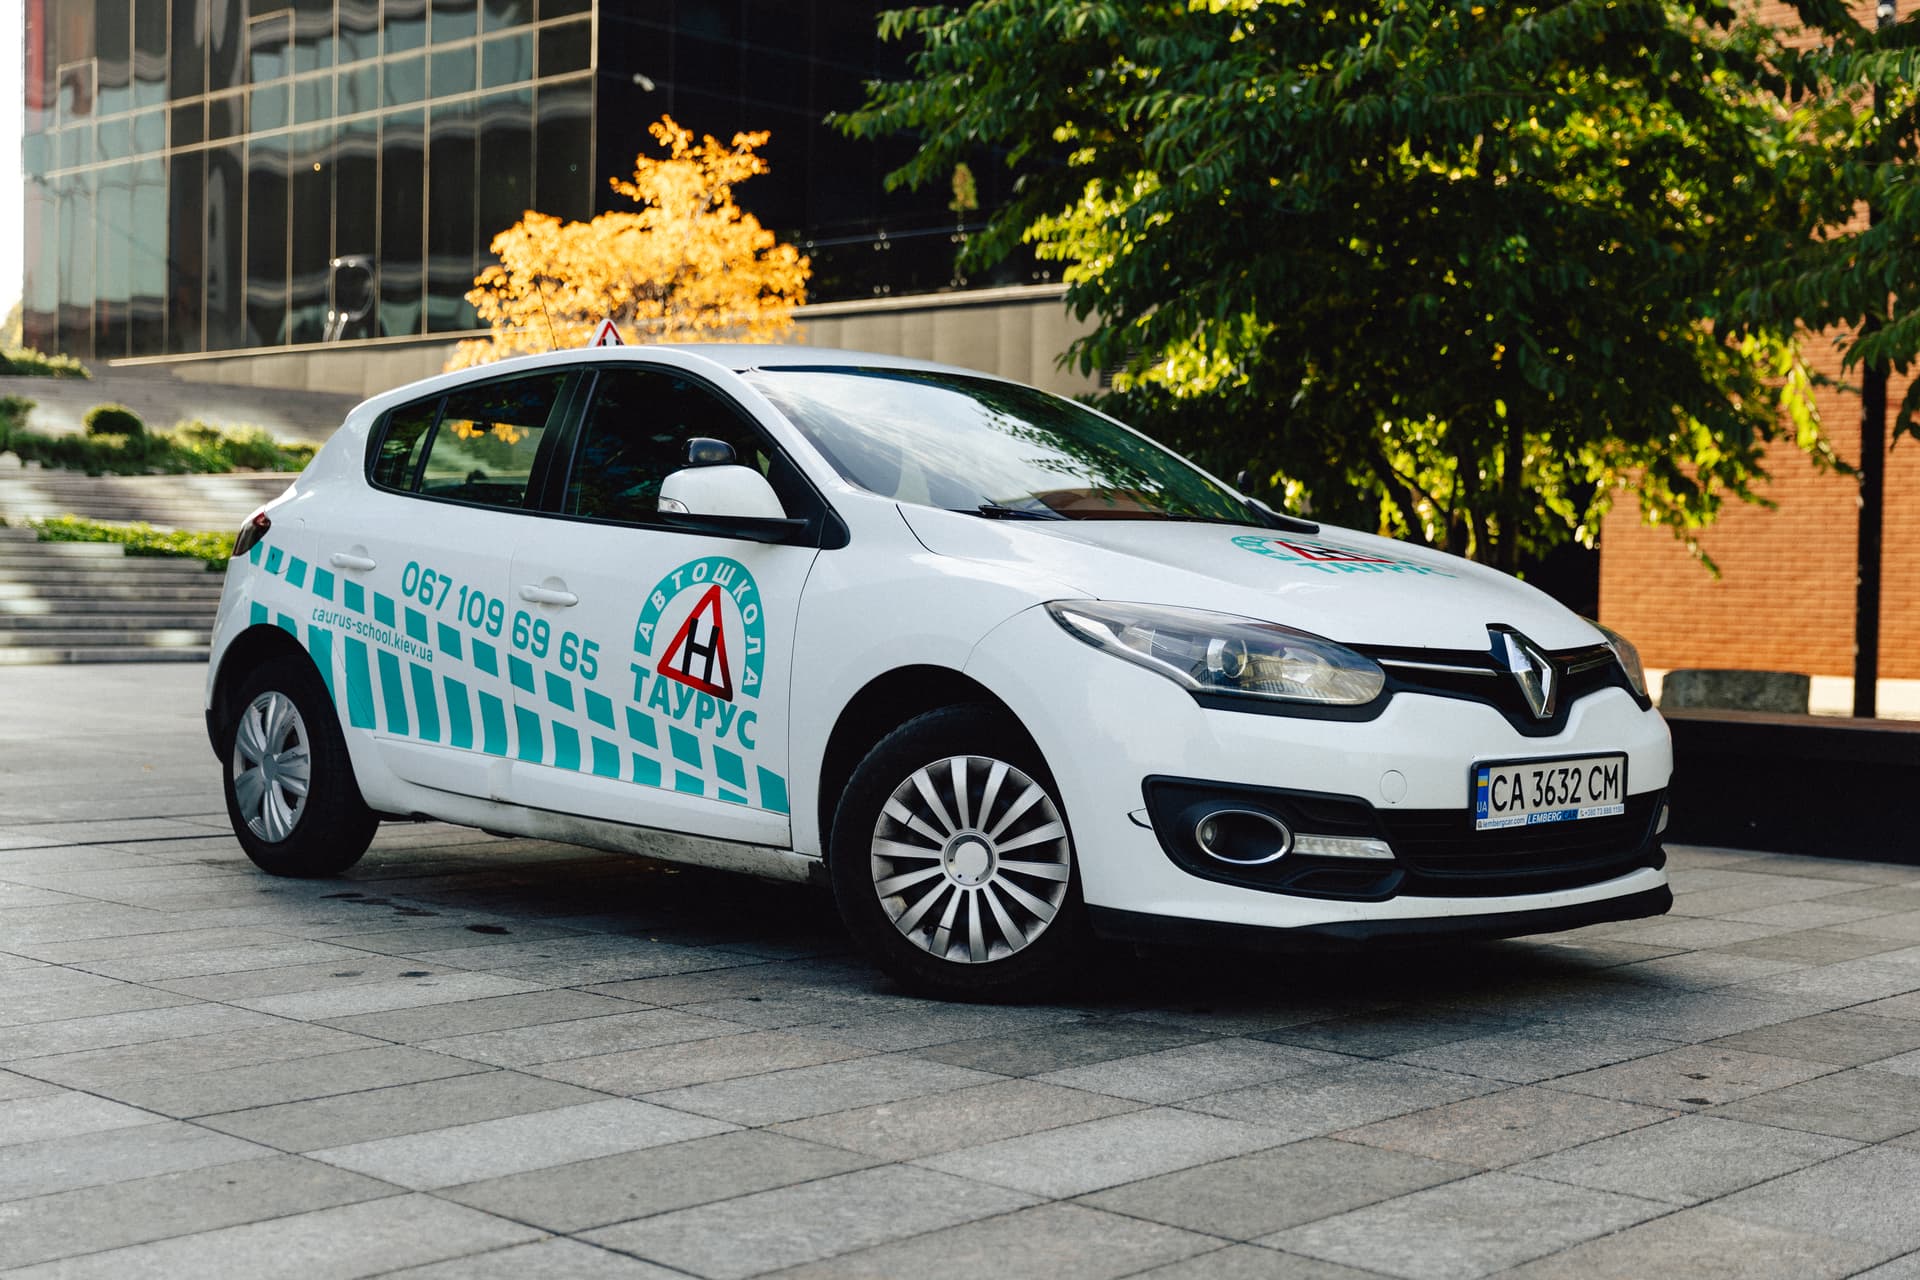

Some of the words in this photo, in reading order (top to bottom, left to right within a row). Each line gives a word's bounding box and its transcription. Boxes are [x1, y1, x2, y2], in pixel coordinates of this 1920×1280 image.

[311, 607, 433, 663] taurus-school.kiev.ua
[401, 561, 453, 611] 067
[457, 585, 505, 638] 109
[512, 610, 551, 659] 69
[559, 631, 600, 681] 65
[638, 561, 761, 687] АВТОШКОЛА
[630, 662, 758, 750] ТАУРУС
[1477, 801, 1488, 813] UA
[1491, 773, 1525, 811] CA
[1532, 767, 1582, 807] 3632
[1588, 763, 1619, 801] CM
[1528, 811, 1562, 825] LEMBERG
